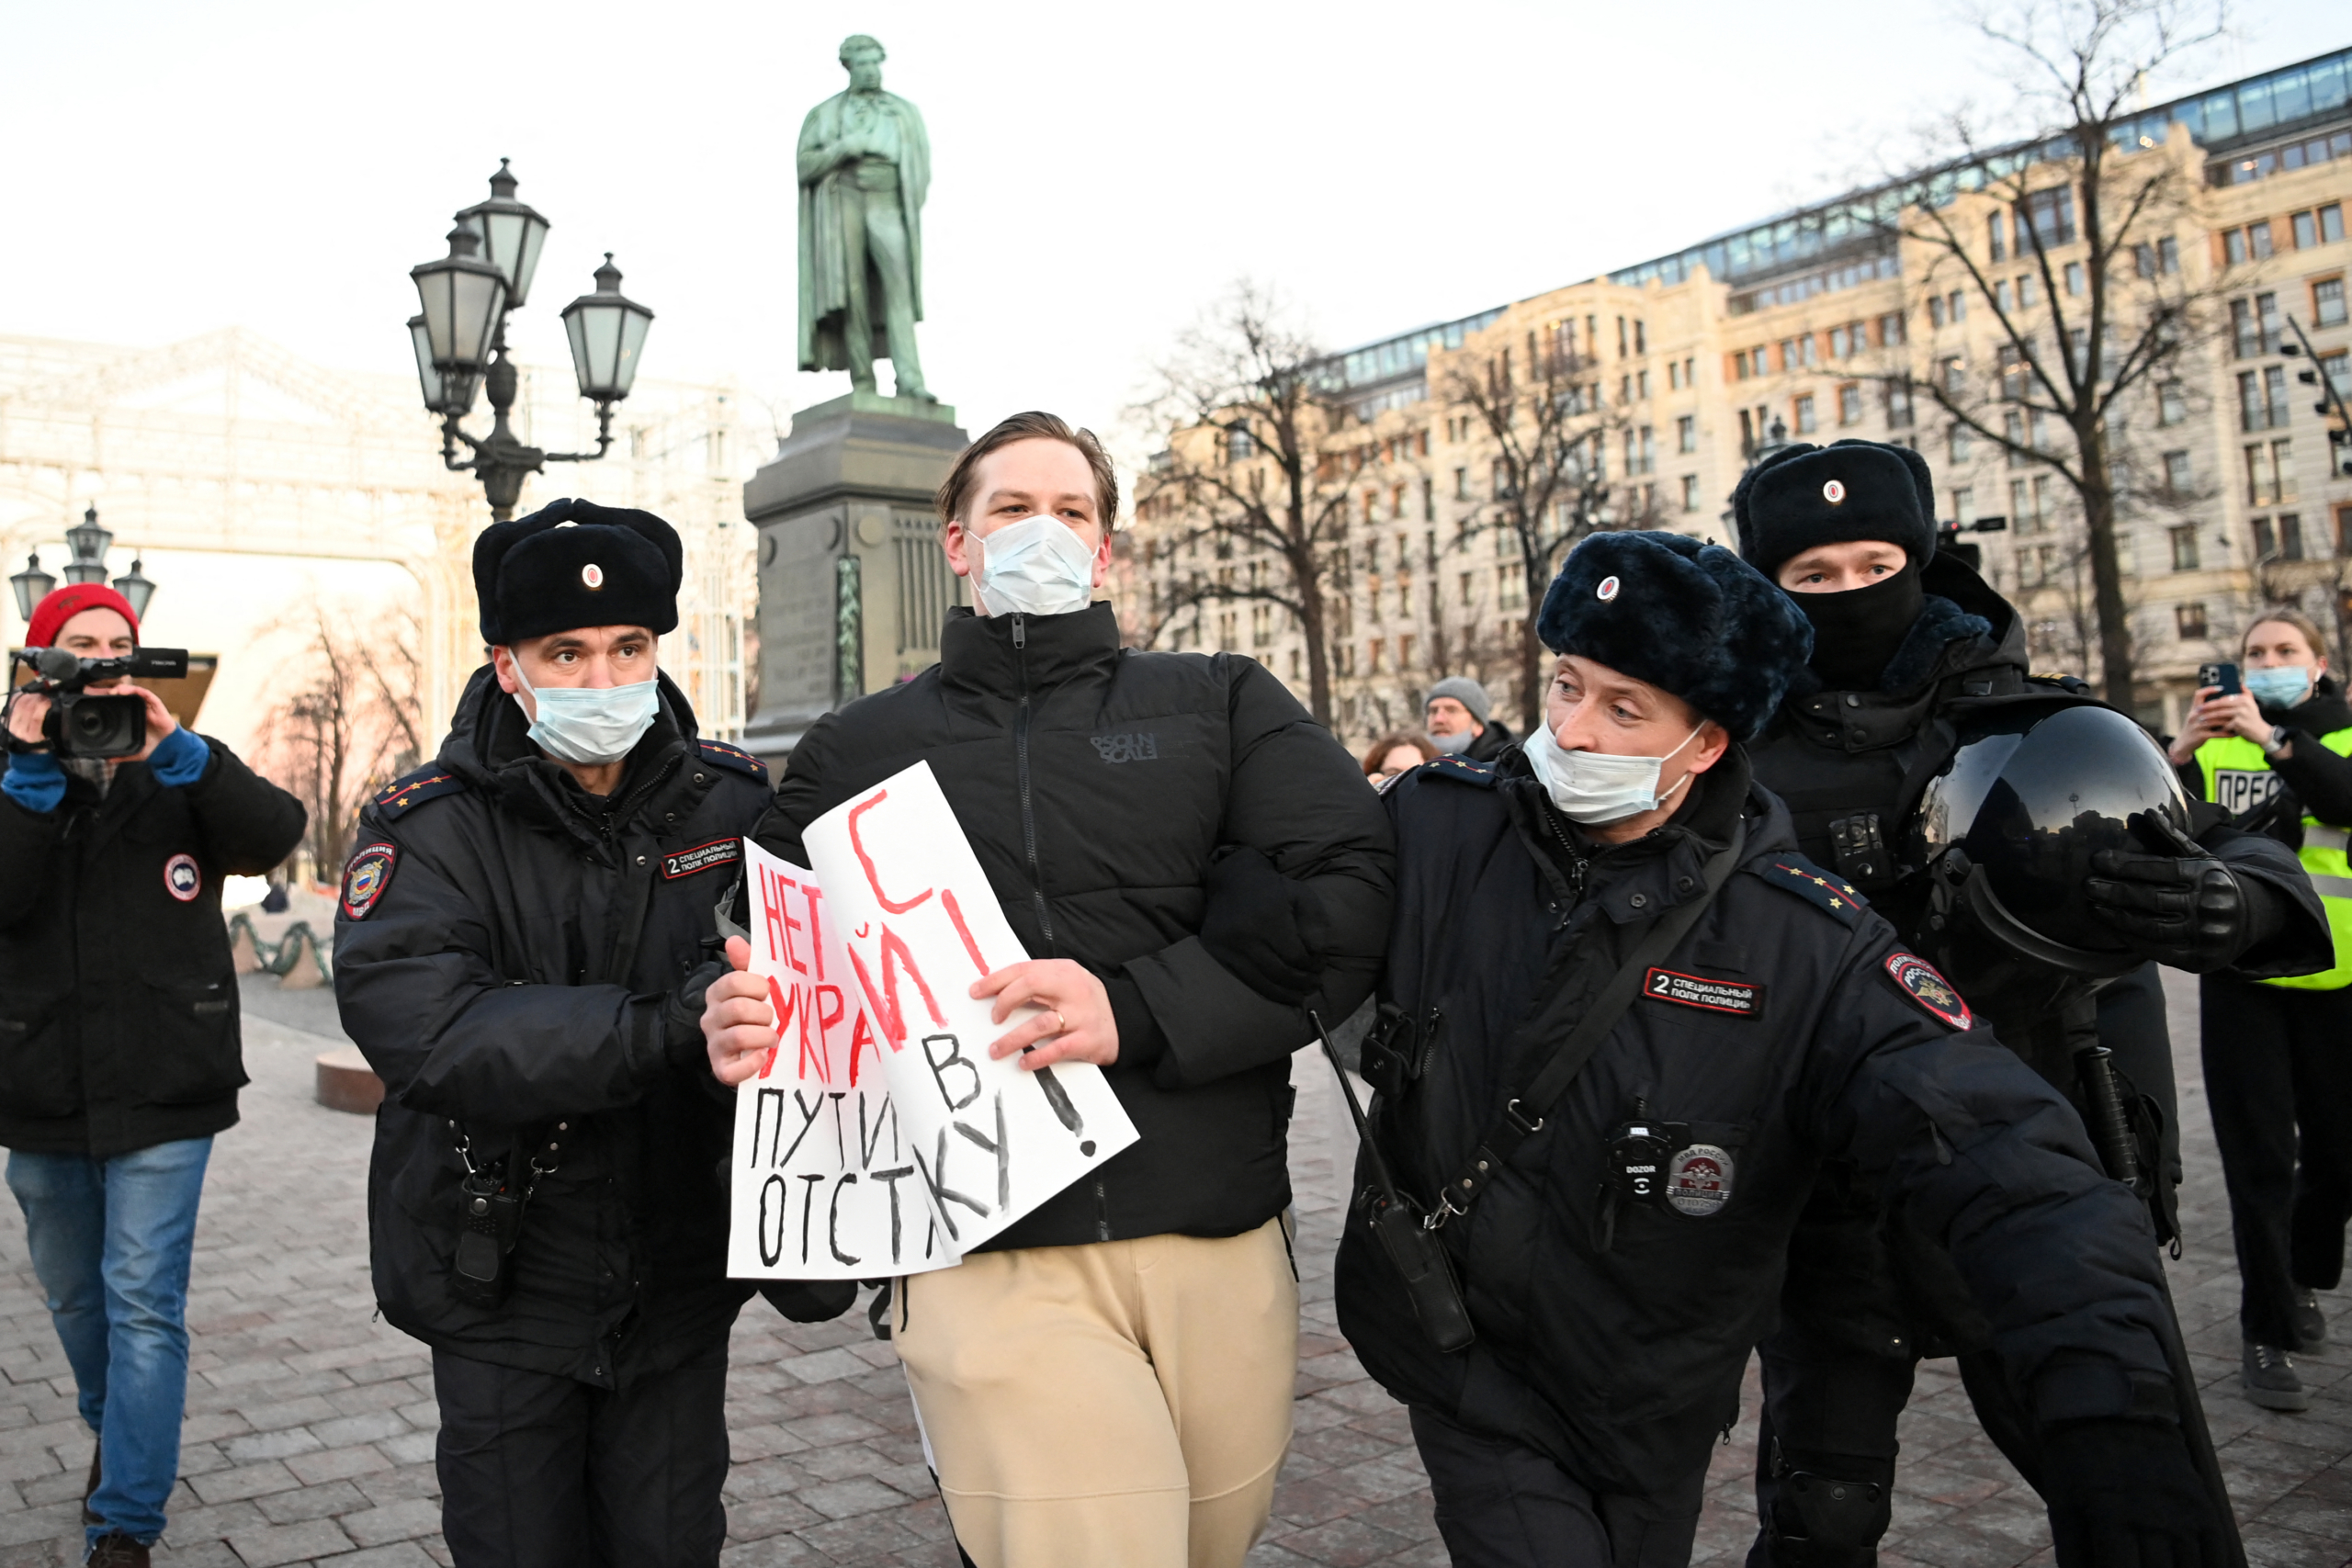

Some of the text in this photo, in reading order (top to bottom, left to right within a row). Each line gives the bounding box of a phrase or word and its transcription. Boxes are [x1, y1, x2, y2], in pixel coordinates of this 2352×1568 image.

[346, 845, 393, 873] ПОЛИЦИЯ
[668, 840, 737, 874] 2 СПЕЦИАЛЬНЫЙ
[681, 851, 738, 871] ПОЛК ПОЛИЦИИ
[848, 789, 933, 915] С
[352, 900, 370, 917] МВД
[758, 863, 824, 981] НЕТ
[1889, 954, 1934, 975] ПОЛИЦИЯ
[1653, 975, 1753, 998] 2 СПЕЦИАЛЬНЫЙ
[1670, 987, 1751, 1009] ПОЛК ПОЛИЦИИ
[922, 1033, 982, 1111] В
[751, 1088, 900, 1170] ПУТИ
[1677, 1149, 1697, 1163] МВД
[1625, 1165, 1657, 1174] DOZOR
